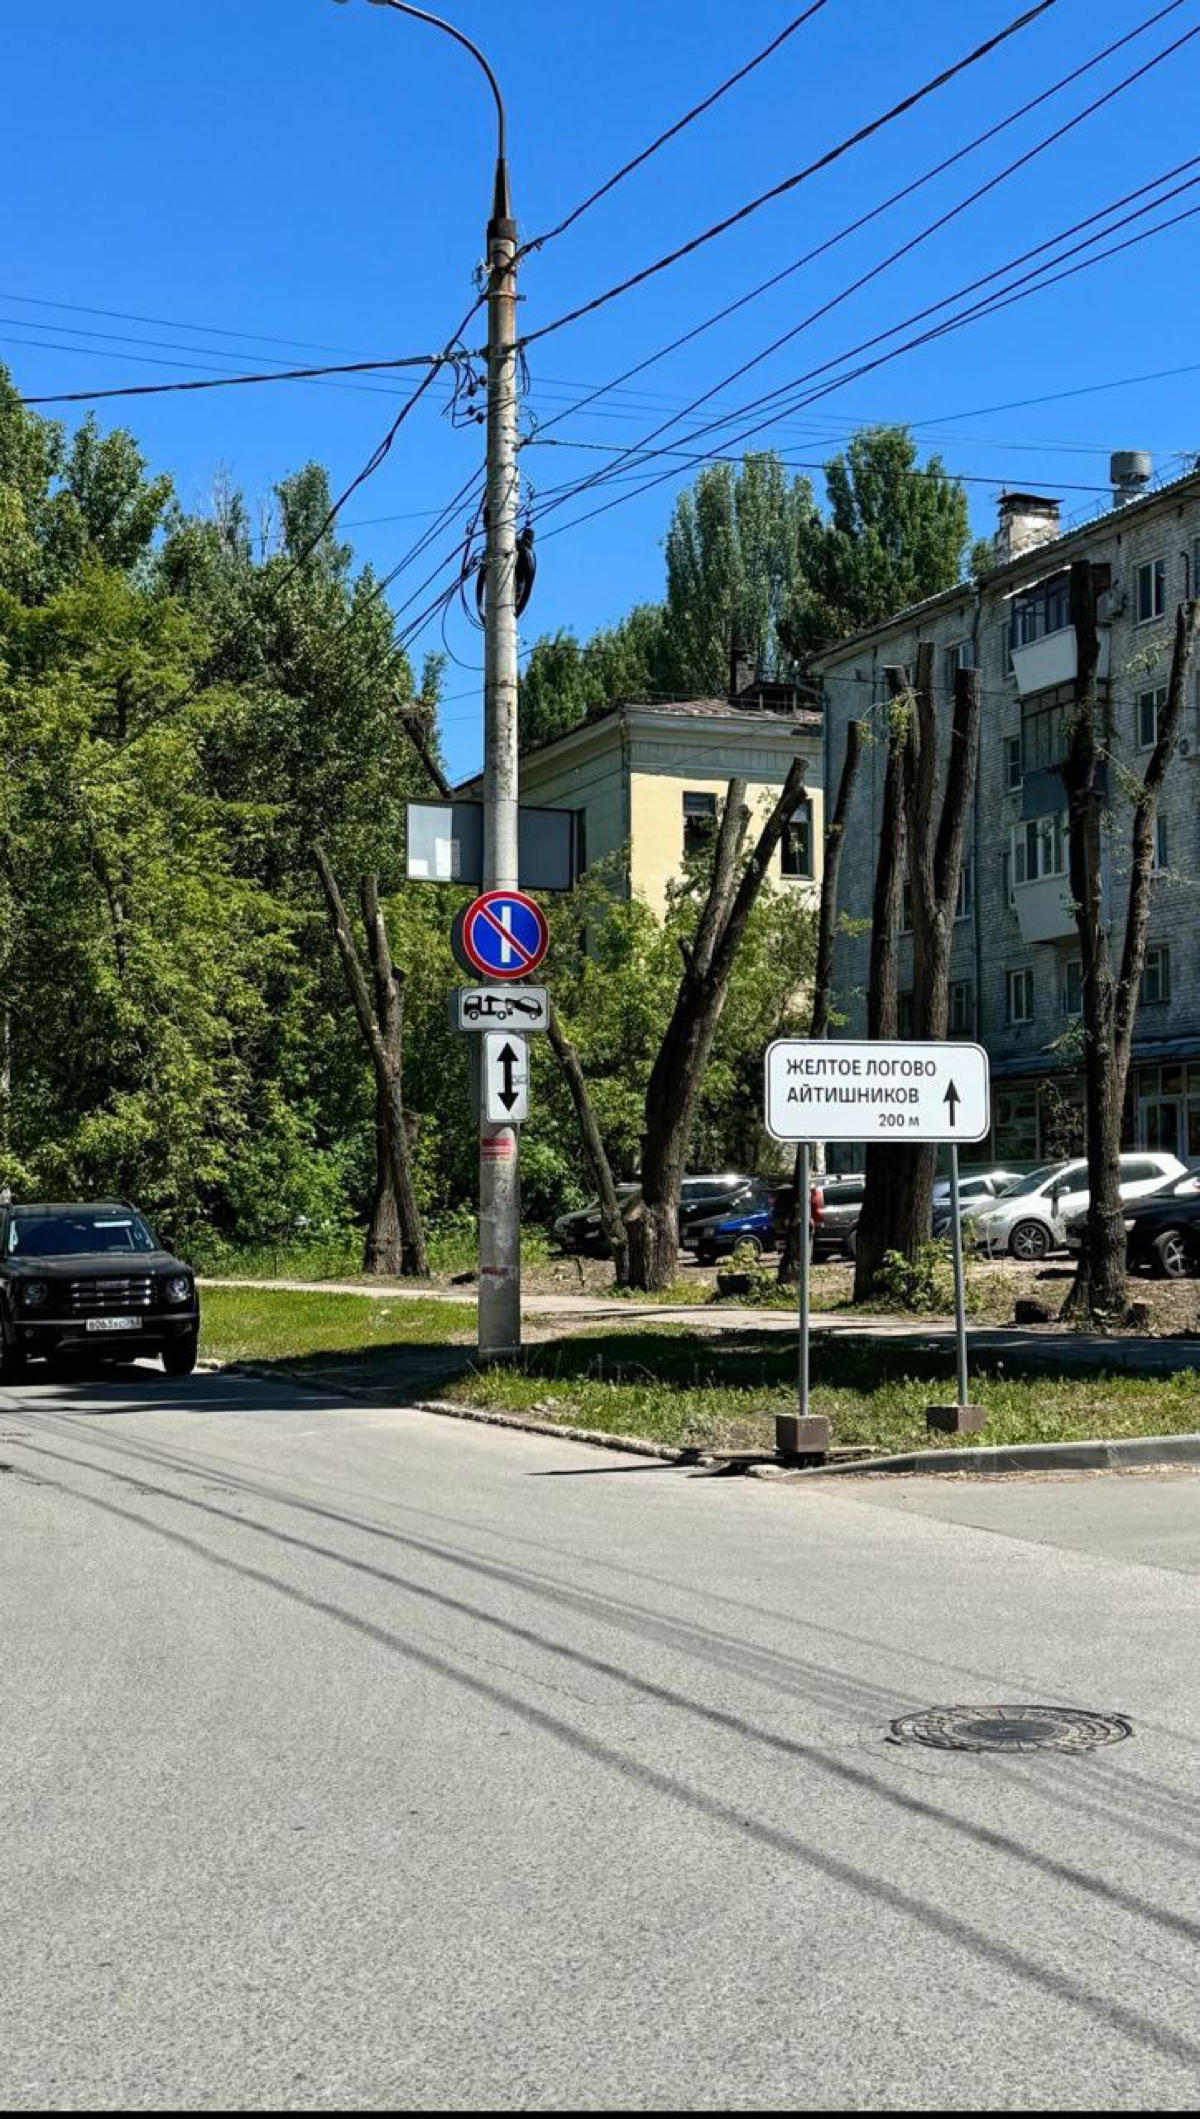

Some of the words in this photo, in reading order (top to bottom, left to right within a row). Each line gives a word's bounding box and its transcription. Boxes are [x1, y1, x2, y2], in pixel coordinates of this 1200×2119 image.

[787, 1058, 861, 1077] ЖЕЛТОЕ
[866, 1060, 936, 1077] ЛОГОВО
[787, 1083, 920, 1104] АЙТИШНИКОВ
[878, 1113, 905, 1127] 200
[908, 1115, 920, 1127] м
